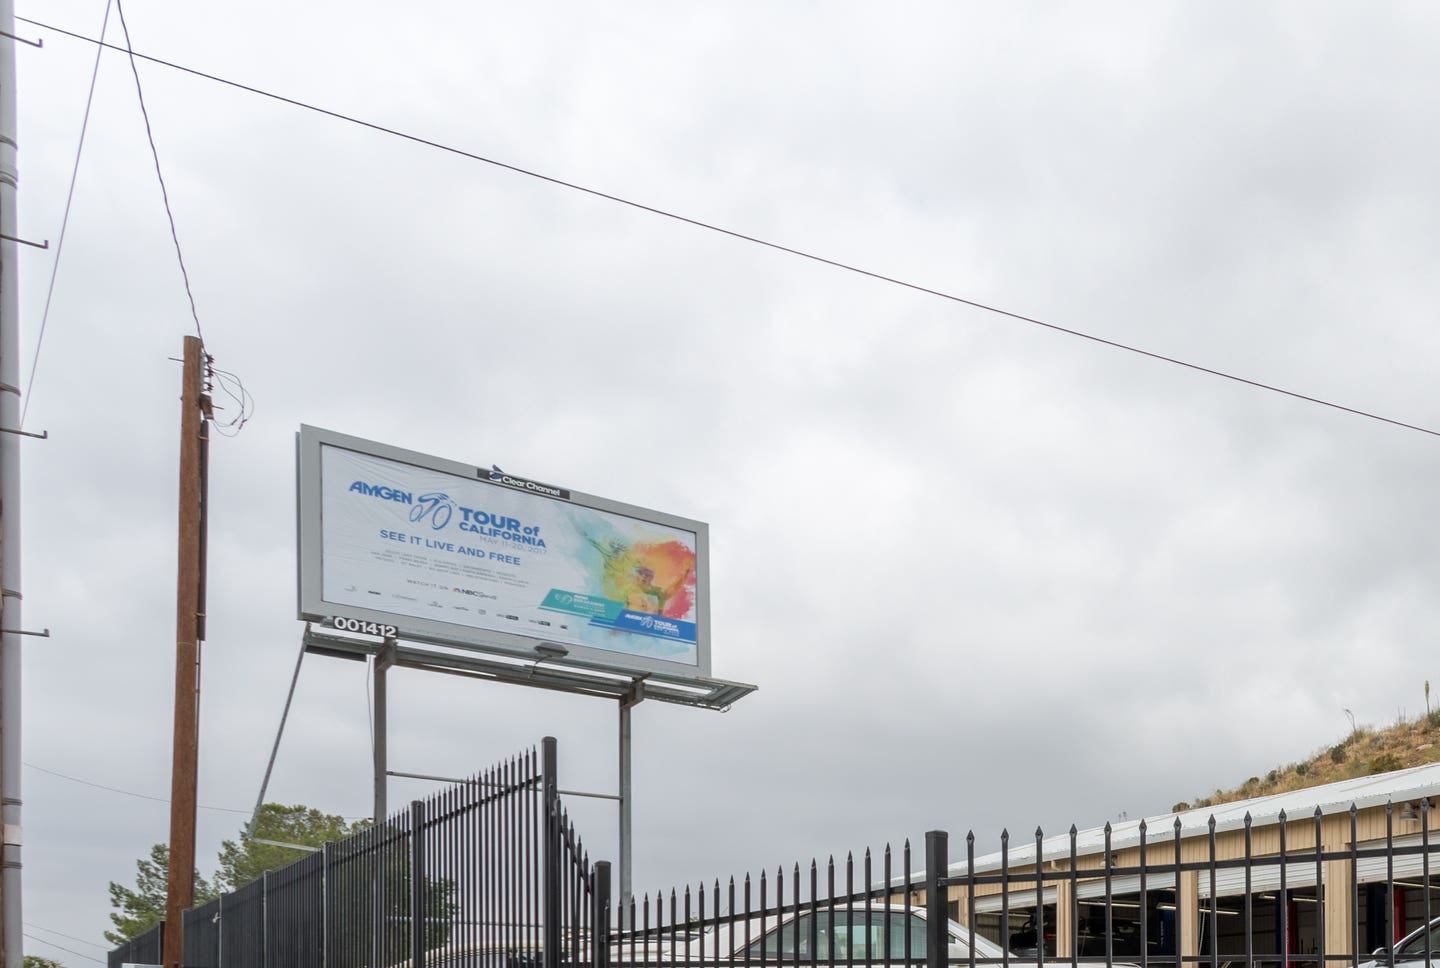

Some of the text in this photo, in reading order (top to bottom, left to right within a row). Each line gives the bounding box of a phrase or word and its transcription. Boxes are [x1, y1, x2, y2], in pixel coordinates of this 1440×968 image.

[349, 480, 412, 505] AMGEN
[502, 475, 560, 496] Clear Channel
[459, 506, 540, 537] TOUR of
[459, 521, 546, 548] CALIFORNIA
[380, 529, 521, 566] SEE IT LIVE AND FREE
[334, 616, 397, 638] 001412
